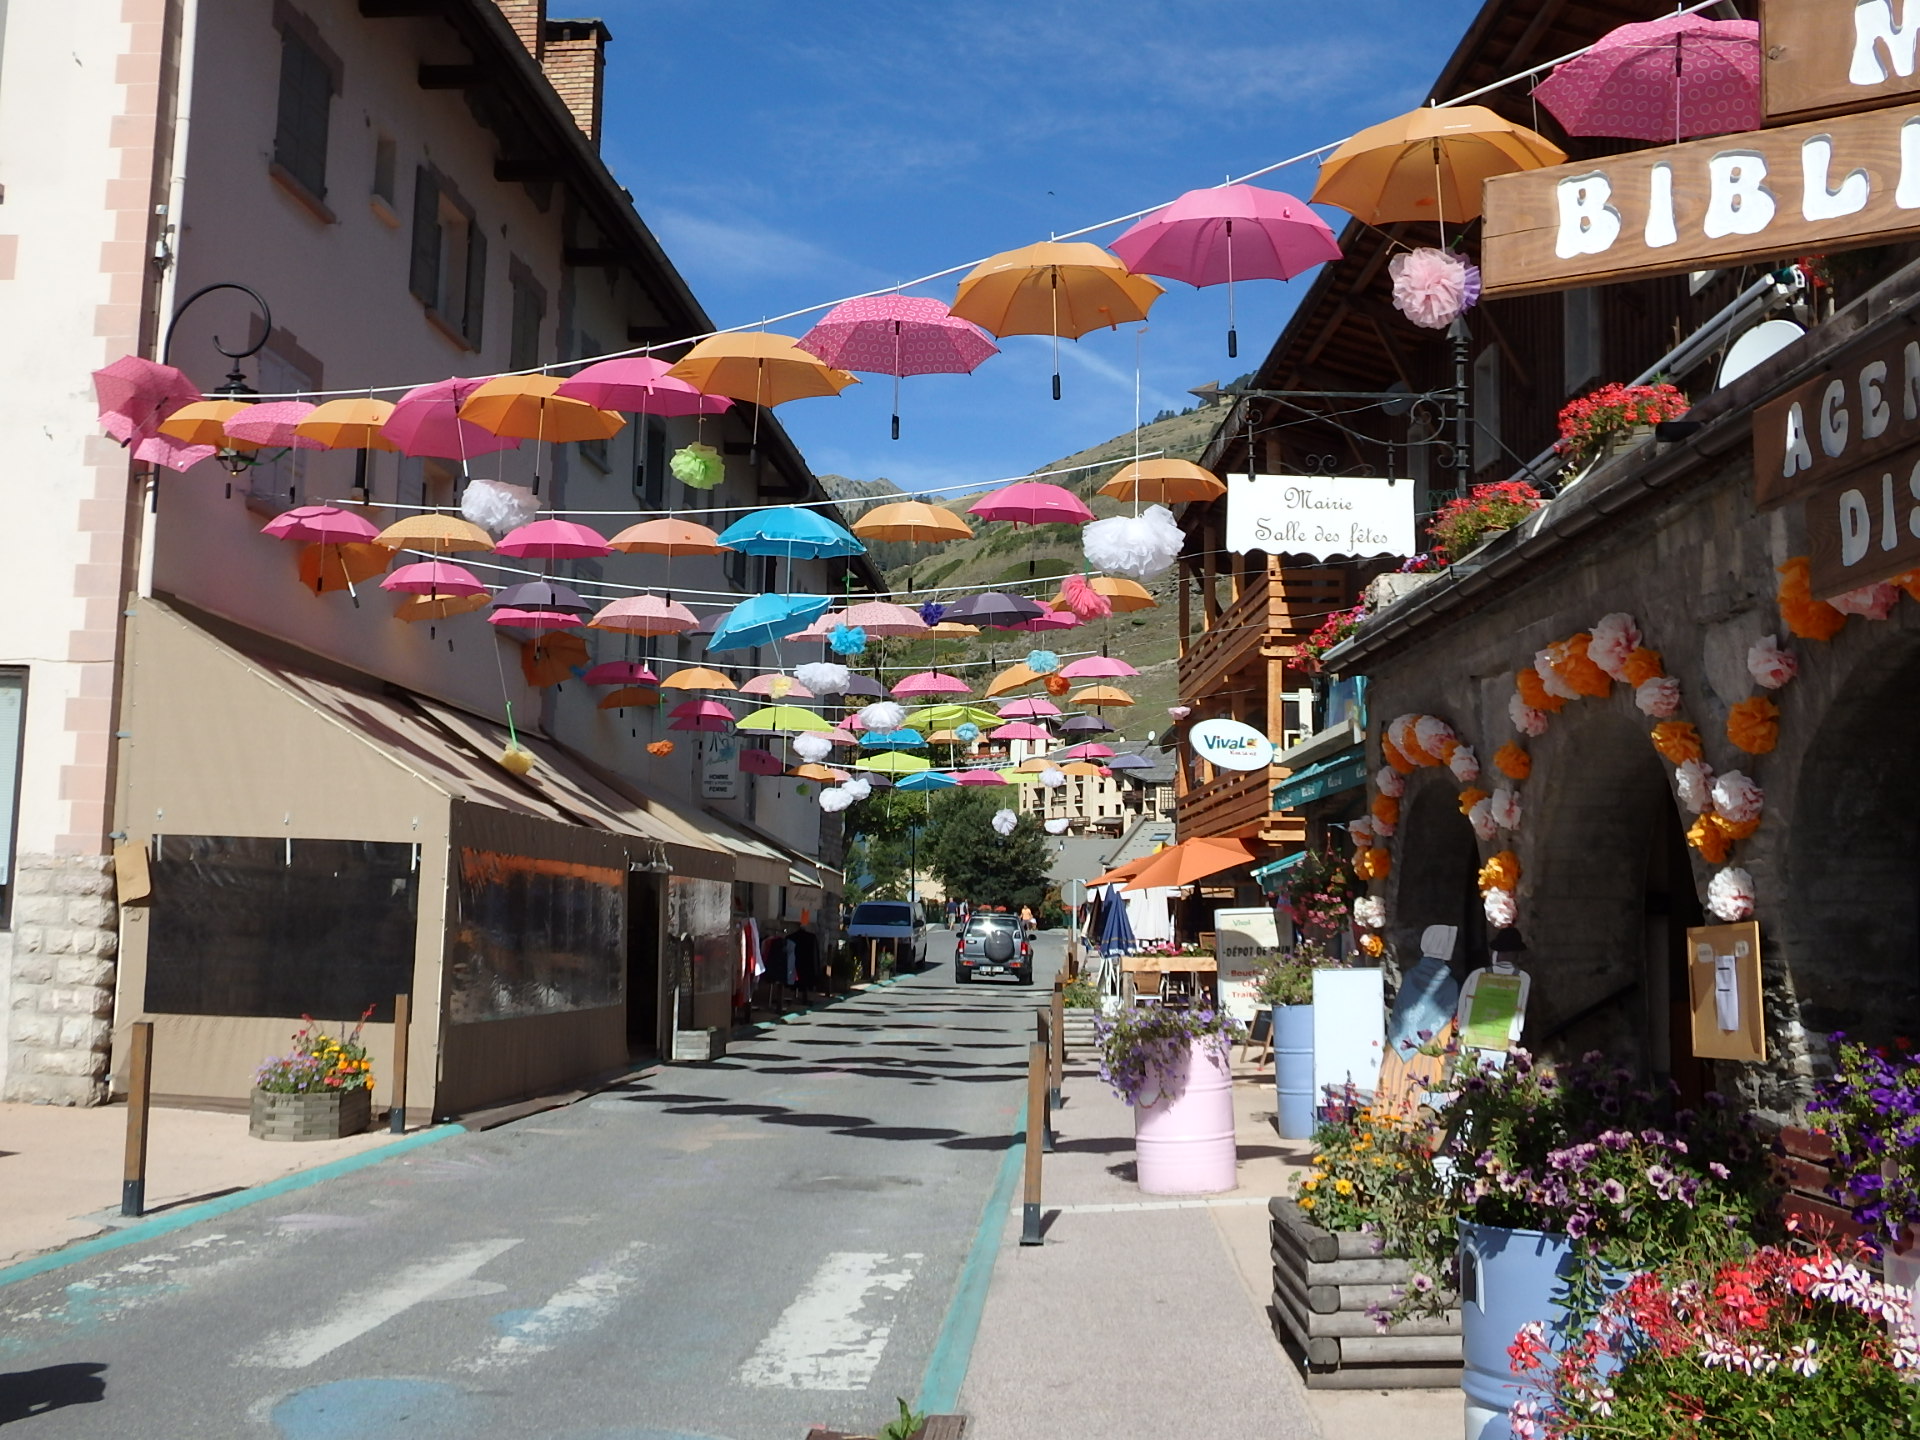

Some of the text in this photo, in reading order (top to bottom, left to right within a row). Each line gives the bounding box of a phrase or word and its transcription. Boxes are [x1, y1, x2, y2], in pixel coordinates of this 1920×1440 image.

[1284, 487, 1353, 510] Mairie
[1255, 517, 1388, 552] Salle des fêtes
